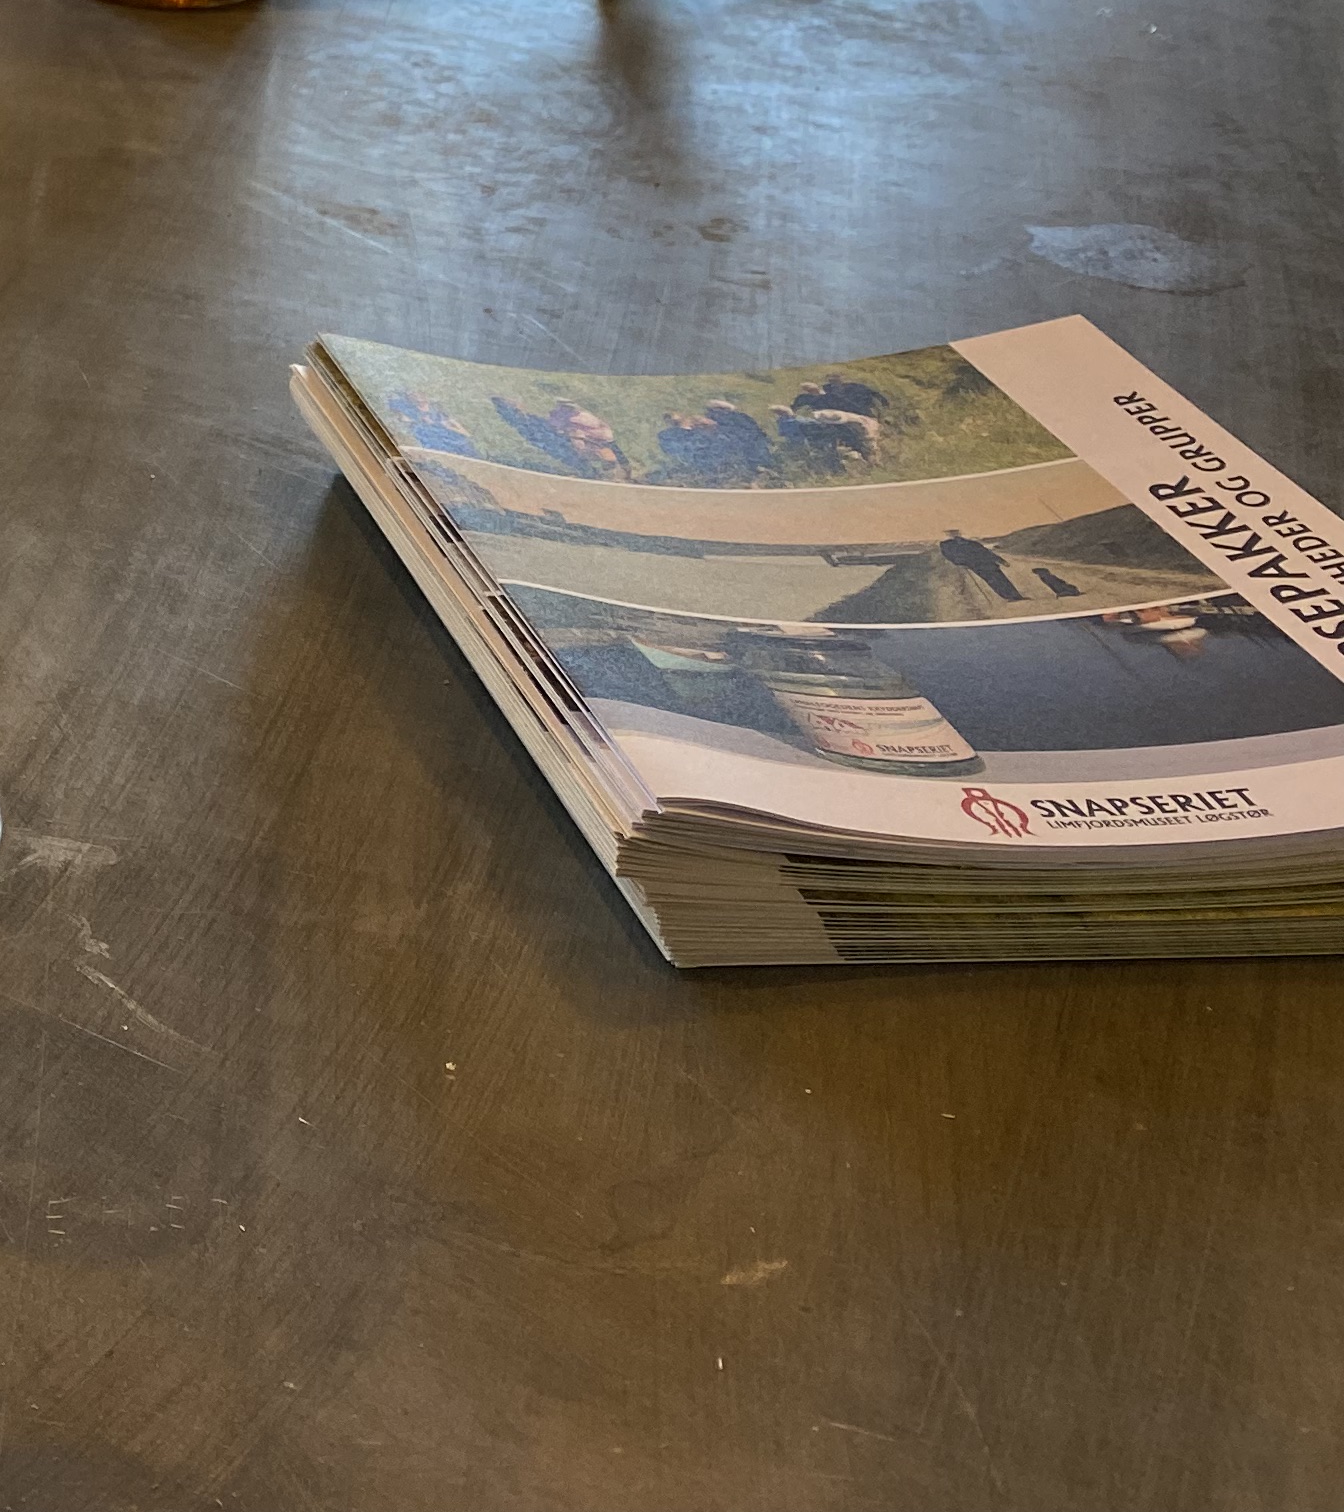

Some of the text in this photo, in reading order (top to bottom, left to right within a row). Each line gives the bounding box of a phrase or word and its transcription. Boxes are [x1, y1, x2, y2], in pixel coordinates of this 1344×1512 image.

[1113, 390, 1344, 585] HEDER OG GRUPPER
[1148, 475, 1344, 656] SEPAKKER
[875, 744, 954, 754] SNAPSERIET
[1030, 787, 1258, 819] SNAPSERIET
[1046, 807, 1275, 830] LIMFJORDSMUSEET LØGSTØR
